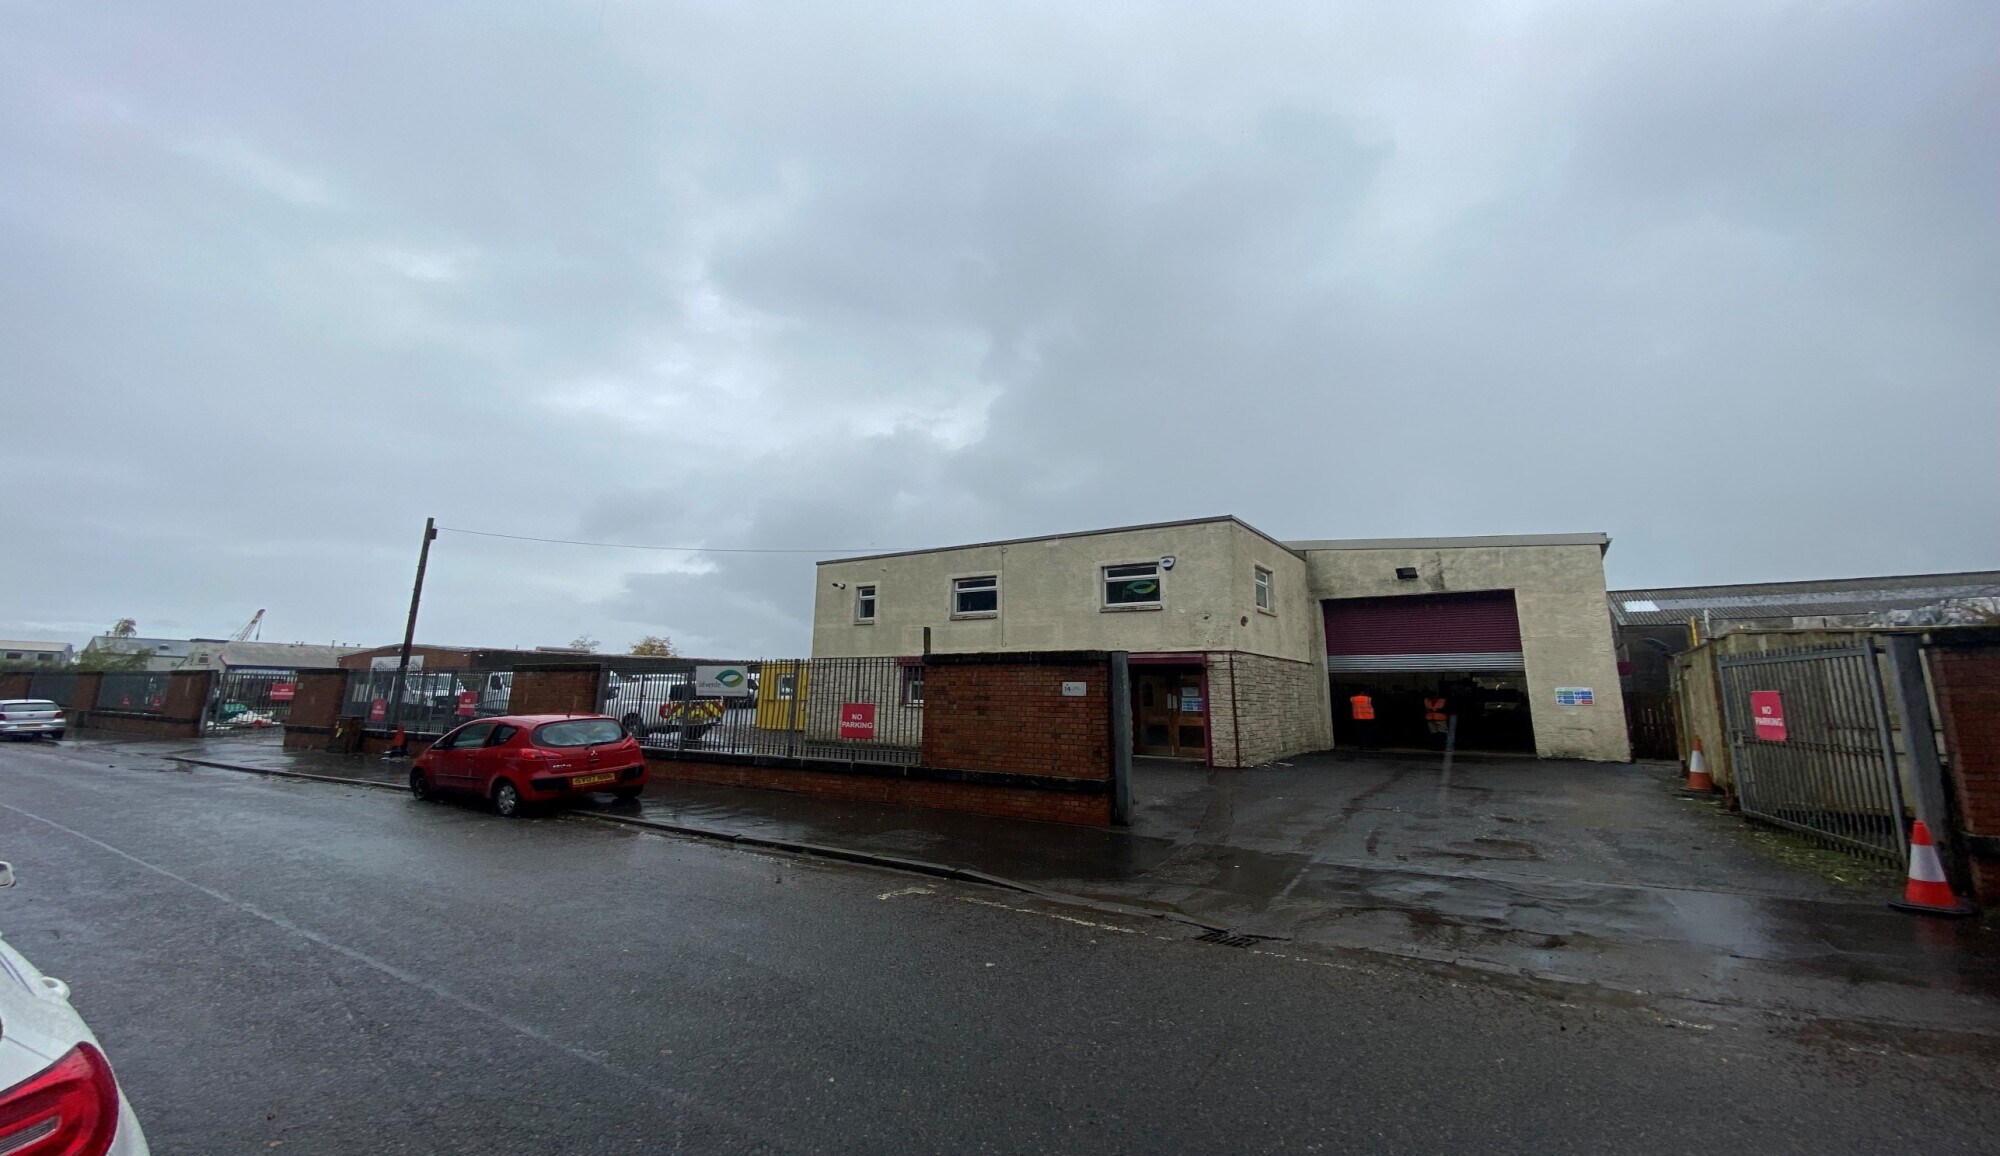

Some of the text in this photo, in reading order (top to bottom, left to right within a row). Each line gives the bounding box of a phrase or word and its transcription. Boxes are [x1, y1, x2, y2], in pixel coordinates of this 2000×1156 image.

[1761, 706, 1772, 715] NO
[842, 721, 873, 729] PARKING
[1755, 717, 1783, 726] PARKING
